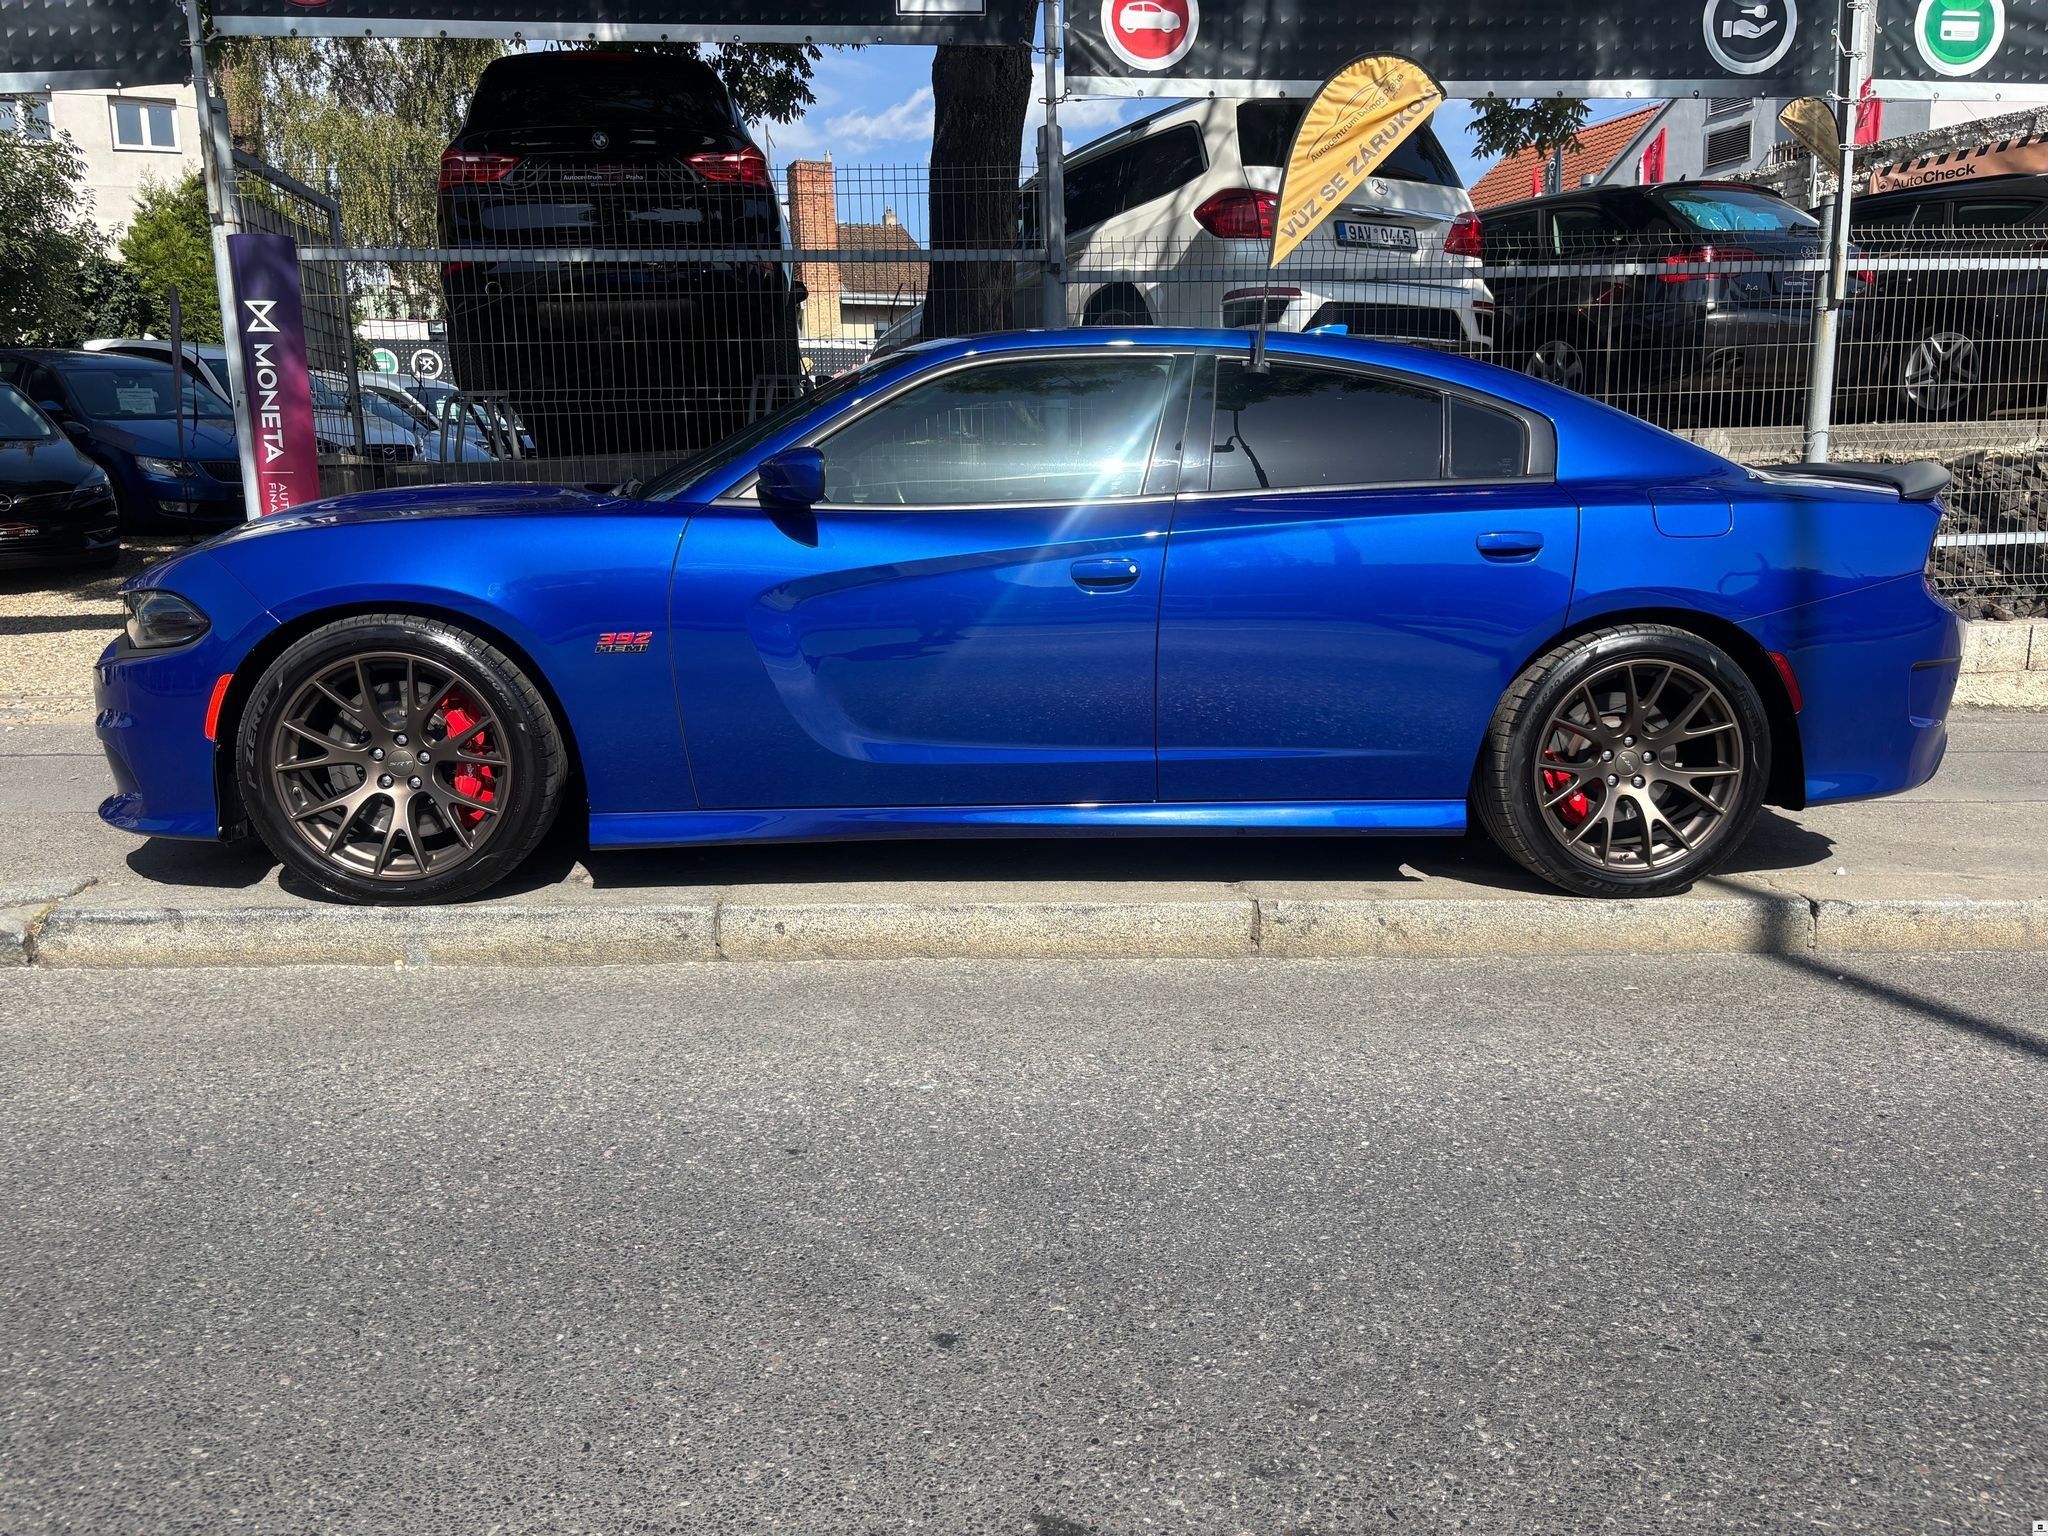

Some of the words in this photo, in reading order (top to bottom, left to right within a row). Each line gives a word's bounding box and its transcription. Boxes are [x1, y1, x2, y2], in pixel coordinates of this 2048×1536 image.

[1311, 116, 1360, 163] Autocentrum
[1383, 73, 1404, 98] Praha
[1891, 163, 1976, 190] AutoCheck
[1280, 199, 1323, 239] VŮZ
[1320, 172, 1349, 202] SE
[1348, 225, 1371, 241] 9AV
[1381, 228, 1411, 245] 0445
[254, 343, 285, 464] MONETA
[594, 644, 649, 654] HEMI
[597, 631, 653, 645] 392
[245, 694, 269, 767] ZERO
[246, 771, 257, 790] P
